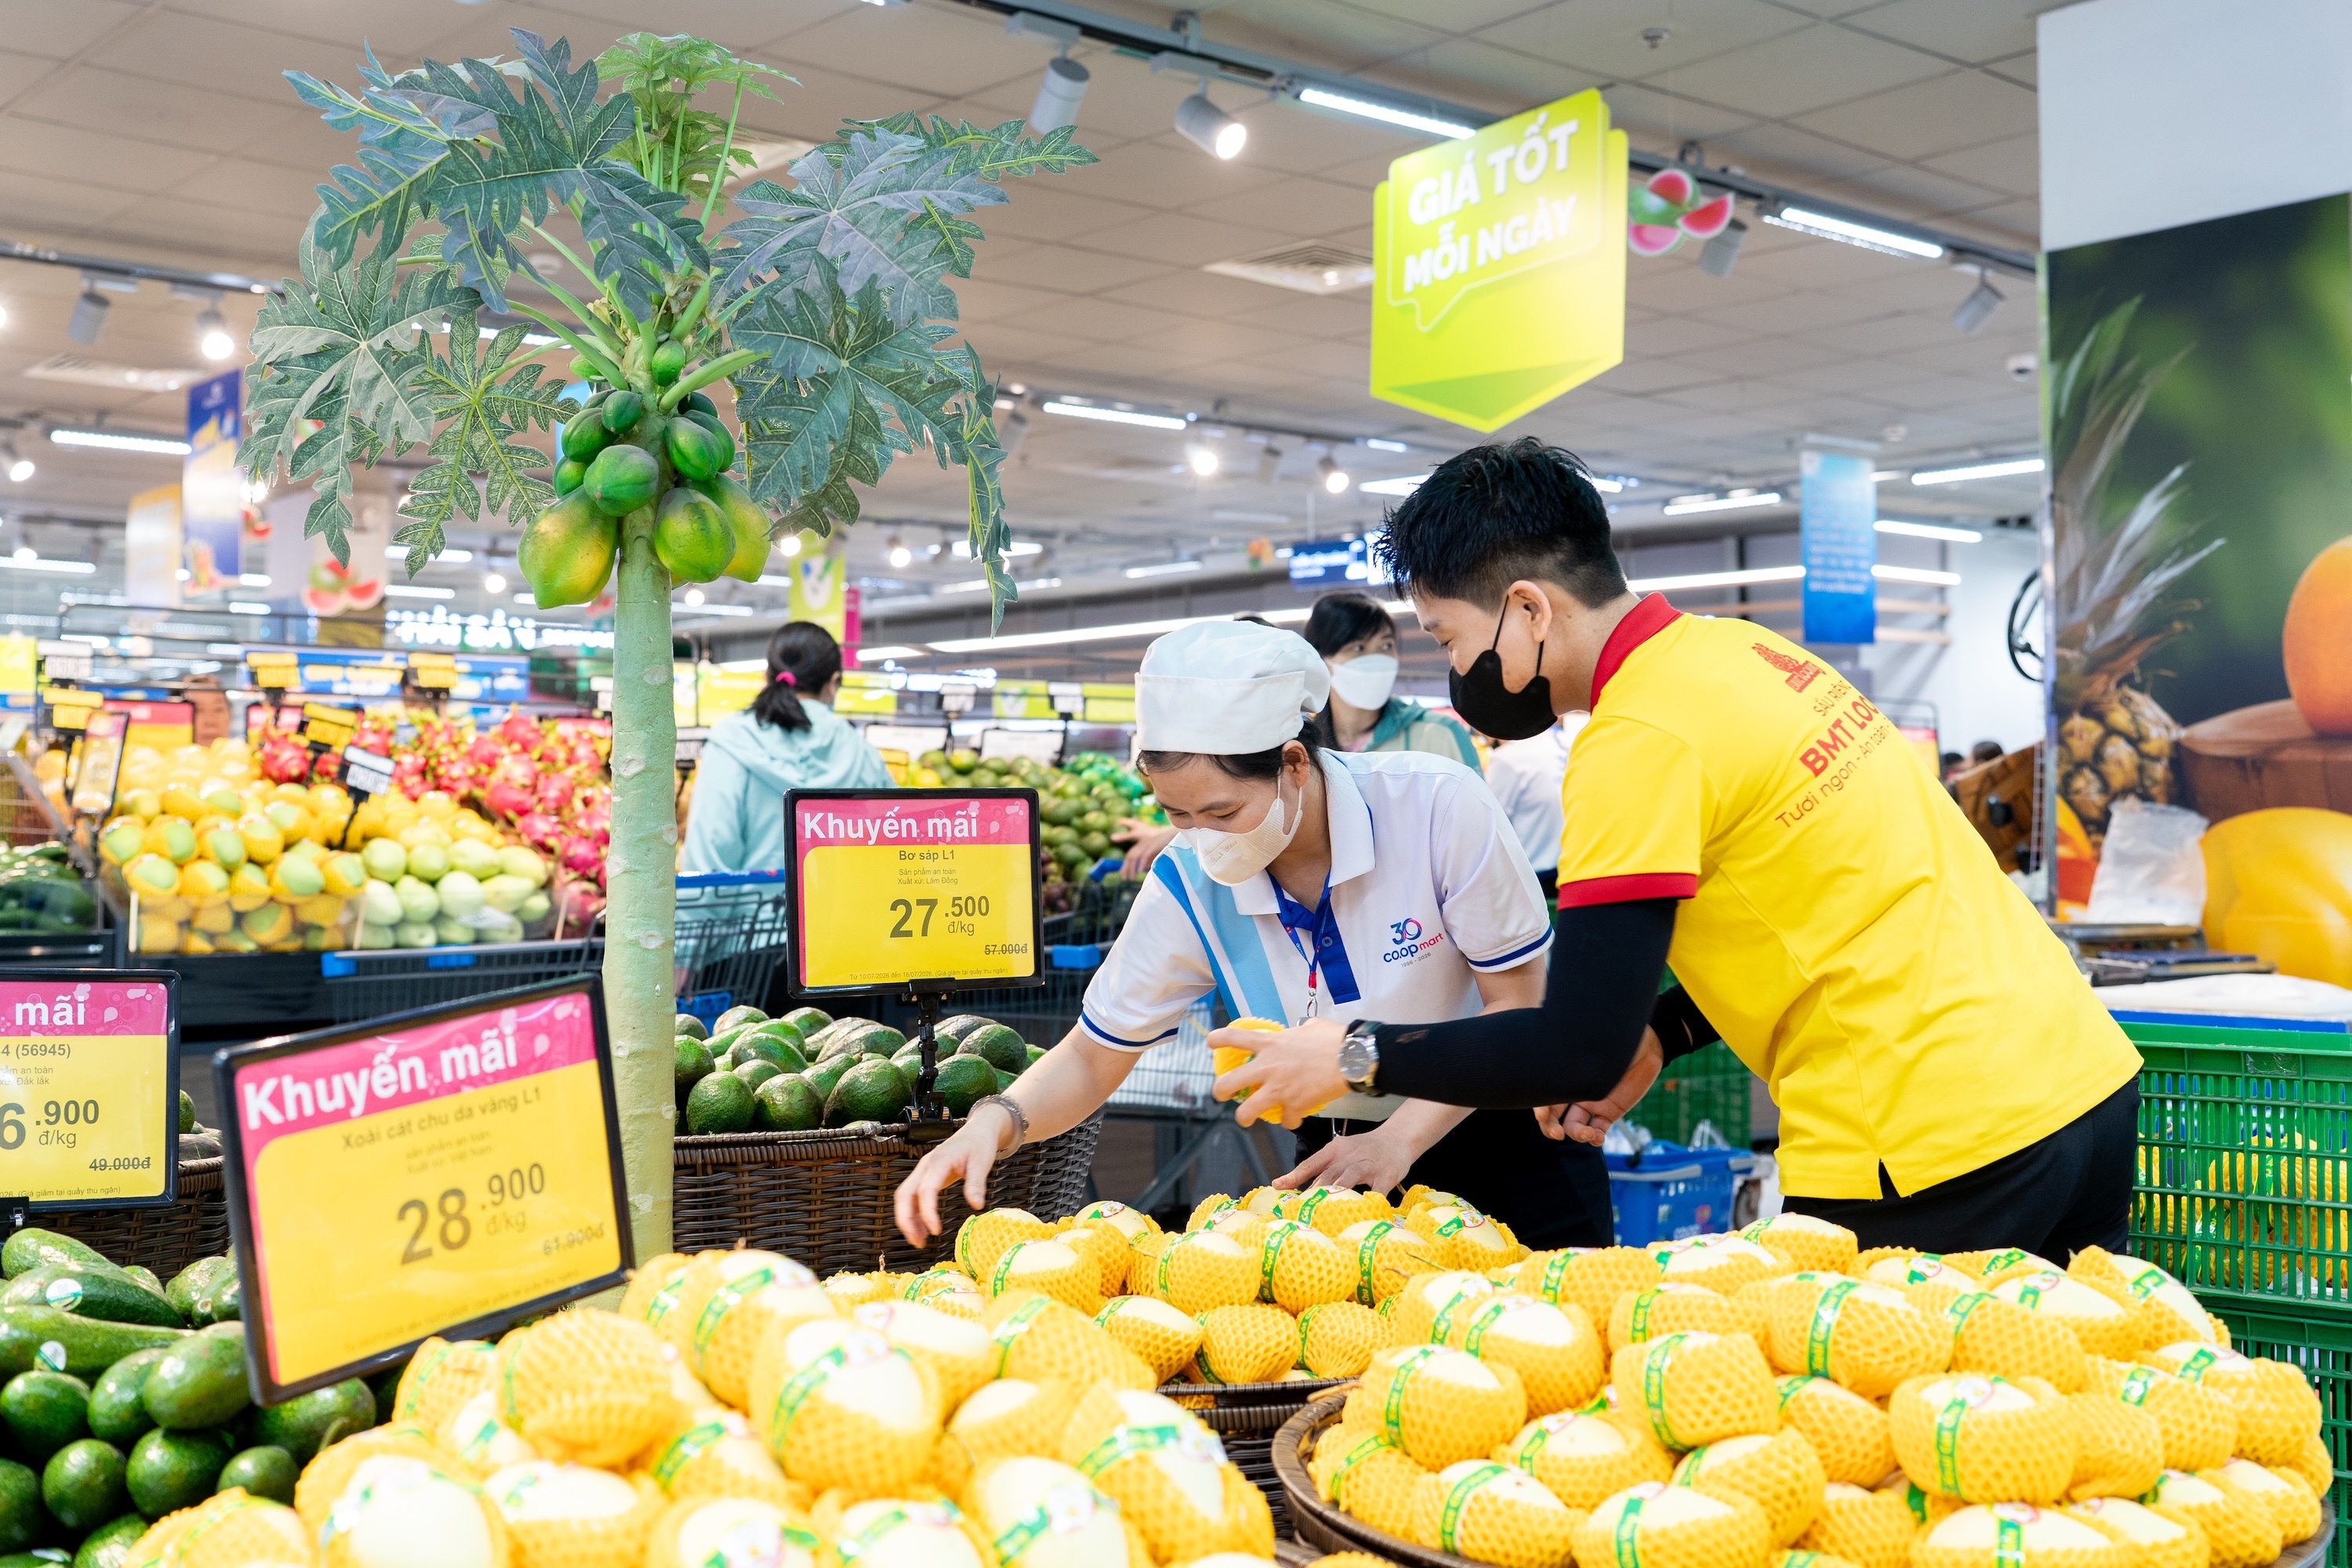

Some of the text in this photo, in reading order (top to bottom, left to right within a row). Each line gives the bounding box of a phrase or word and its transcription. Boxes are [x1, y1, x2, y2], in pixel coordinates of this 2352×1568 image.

[1409, 111, 1579, 225] GIÁ TỐT
[1404, 194, 1577, 293] MỖI NGÀY
[1828, 680, 1851, 702] RIÊN
[1799, 718, 1855, 778] BMT
[1775, 792, 1820, 828] Tươi
[1820, 760, 1857, 797] ngon
[1859, 742, 1875, 759] An
[1870, 726, 1889, 746] toàn
[804, 806, 977, 846] Khuyến mãi
[899, 849, 954, 862] Bơ sáp L1
[913, 867, 931, 877] phẩm
[890, 895, 989, 938] 27 .500
[948, 920, 975, 936] đ/kg
[1391, 918, 1422, 945] 30
[985, 943, 1028, 955] 57.000đ
[1417, 952, 1431, 961] 2026
[16, 995, 85, 1025] mãi
[0, 1044, 71, 1059] 4 (56945)
[16, 1075, 34, 1085] Đắk
[34, 1065, 53, 1074] toàn
[243, 1024, 517, 1131] Khuyến mãi
[0, 1099, 100, 1150] 6 .900
[342, 1087, 541, 1151] Xoài cát chu da vàng L1
[38, 1130, 76, 1149] đ/kg
[89, 1156, 151, 1171] 49.000đ
[100, 1186, 121, 1195] ngân)
[1308, 1194, 1323, 1205] Chu
[397, 1163, 544, 1266] 28 .900
[486, 1210, 527, 1236] đ/kg
[1442, 1222, 1457, 1235] Chu
